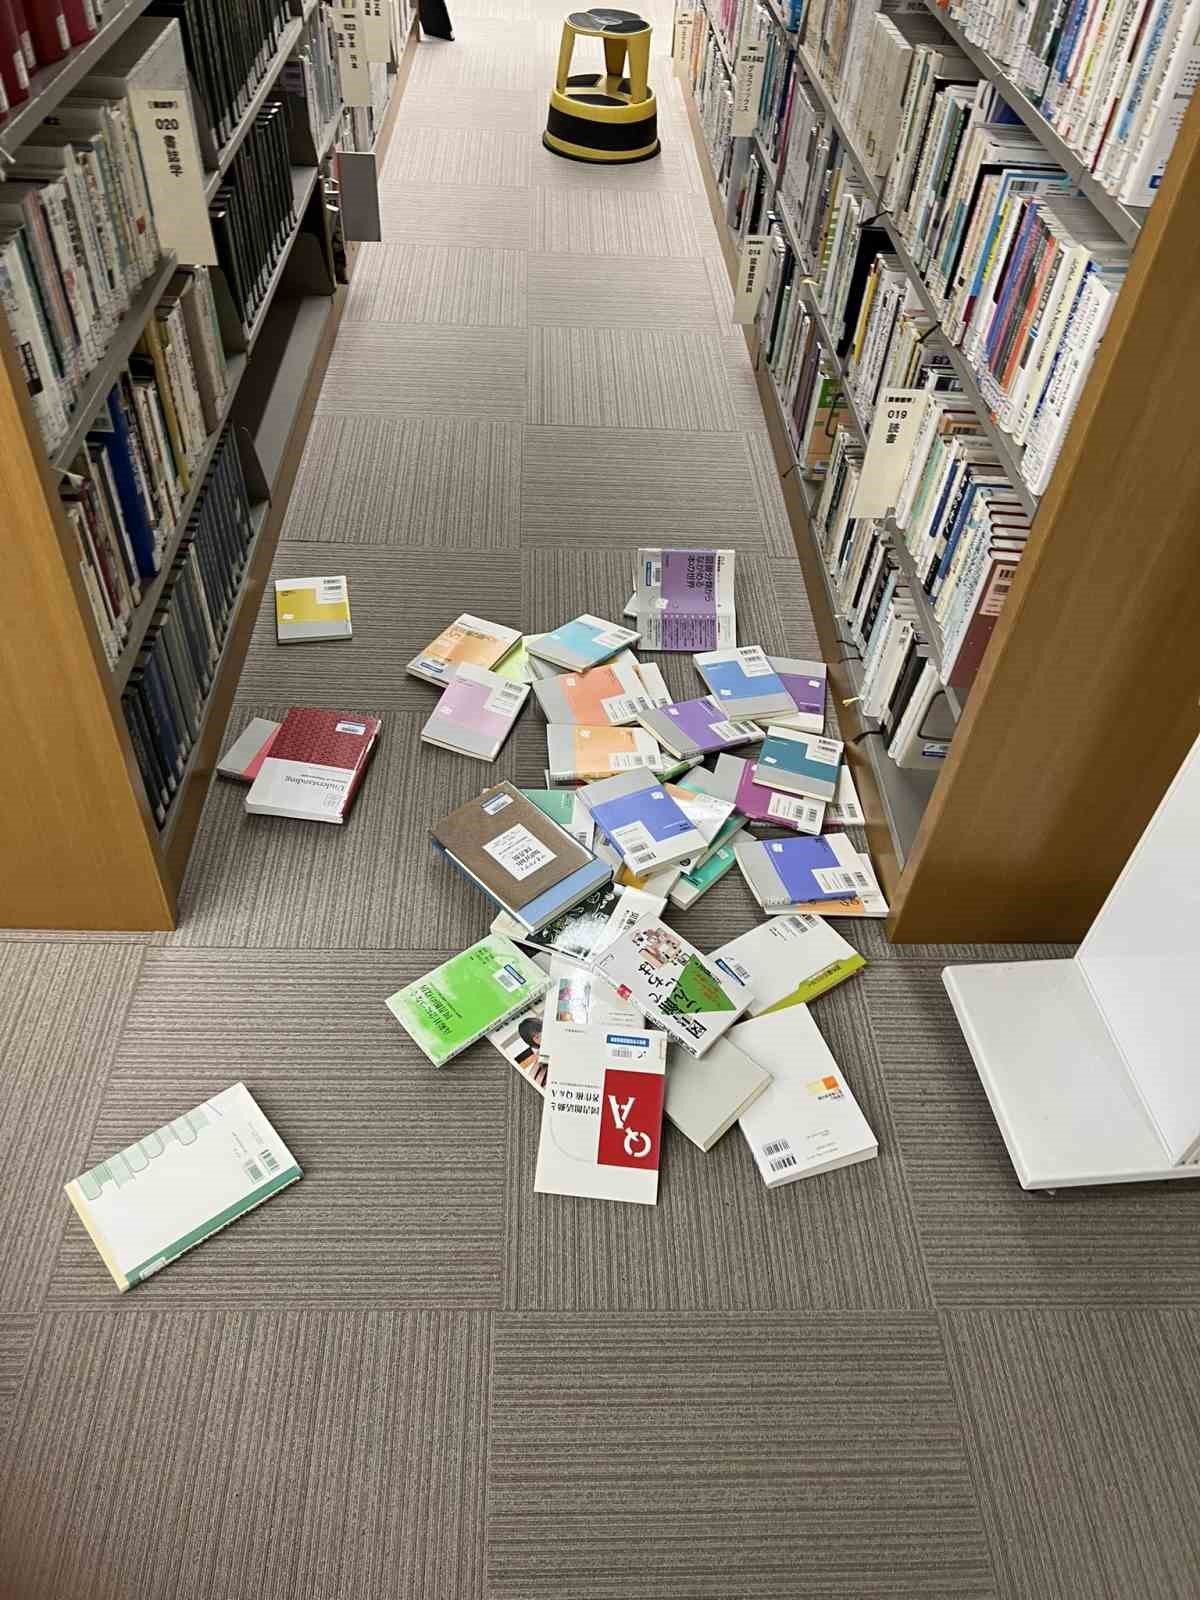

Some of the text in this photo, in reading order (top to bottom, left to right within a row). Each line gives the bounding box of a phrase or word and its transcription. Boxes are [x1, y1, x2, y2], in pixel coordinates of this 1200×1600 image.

[155, 118, 179, 130] 020
[887, 410, 908, 420] 019
[885, 423, 901, 444] 読書
[285, 775, 346, 792] Understanding
[637, 960, 703, 1014] こんにちは
[648, 992, 708, 1039] 図書館で
